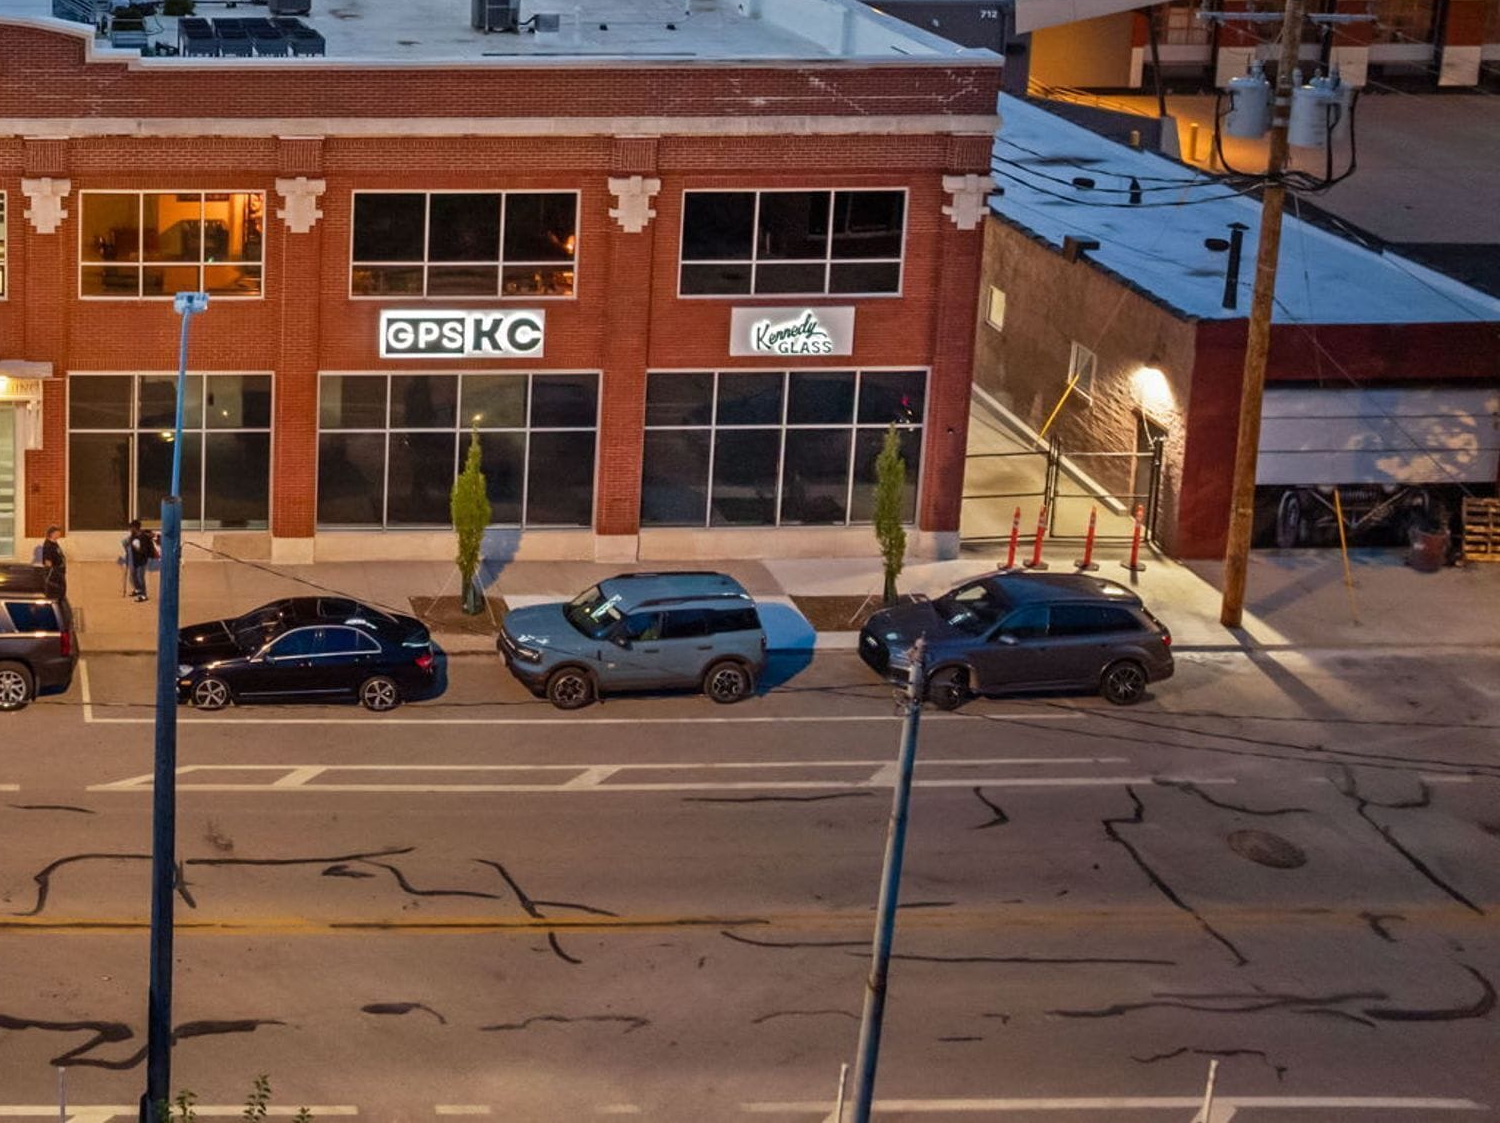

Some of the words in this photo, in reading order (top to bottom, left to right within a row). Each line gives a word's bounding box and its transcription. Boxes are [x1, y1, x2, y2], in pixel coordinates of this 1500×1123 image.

[980, 9, 998, 19] 712
[387, 322, 463, 349] GPS
[473, 318, 542, 351] KC
[756, 313, 828, 350] Kennedy
[779, 341, 832, 354] GLASS
